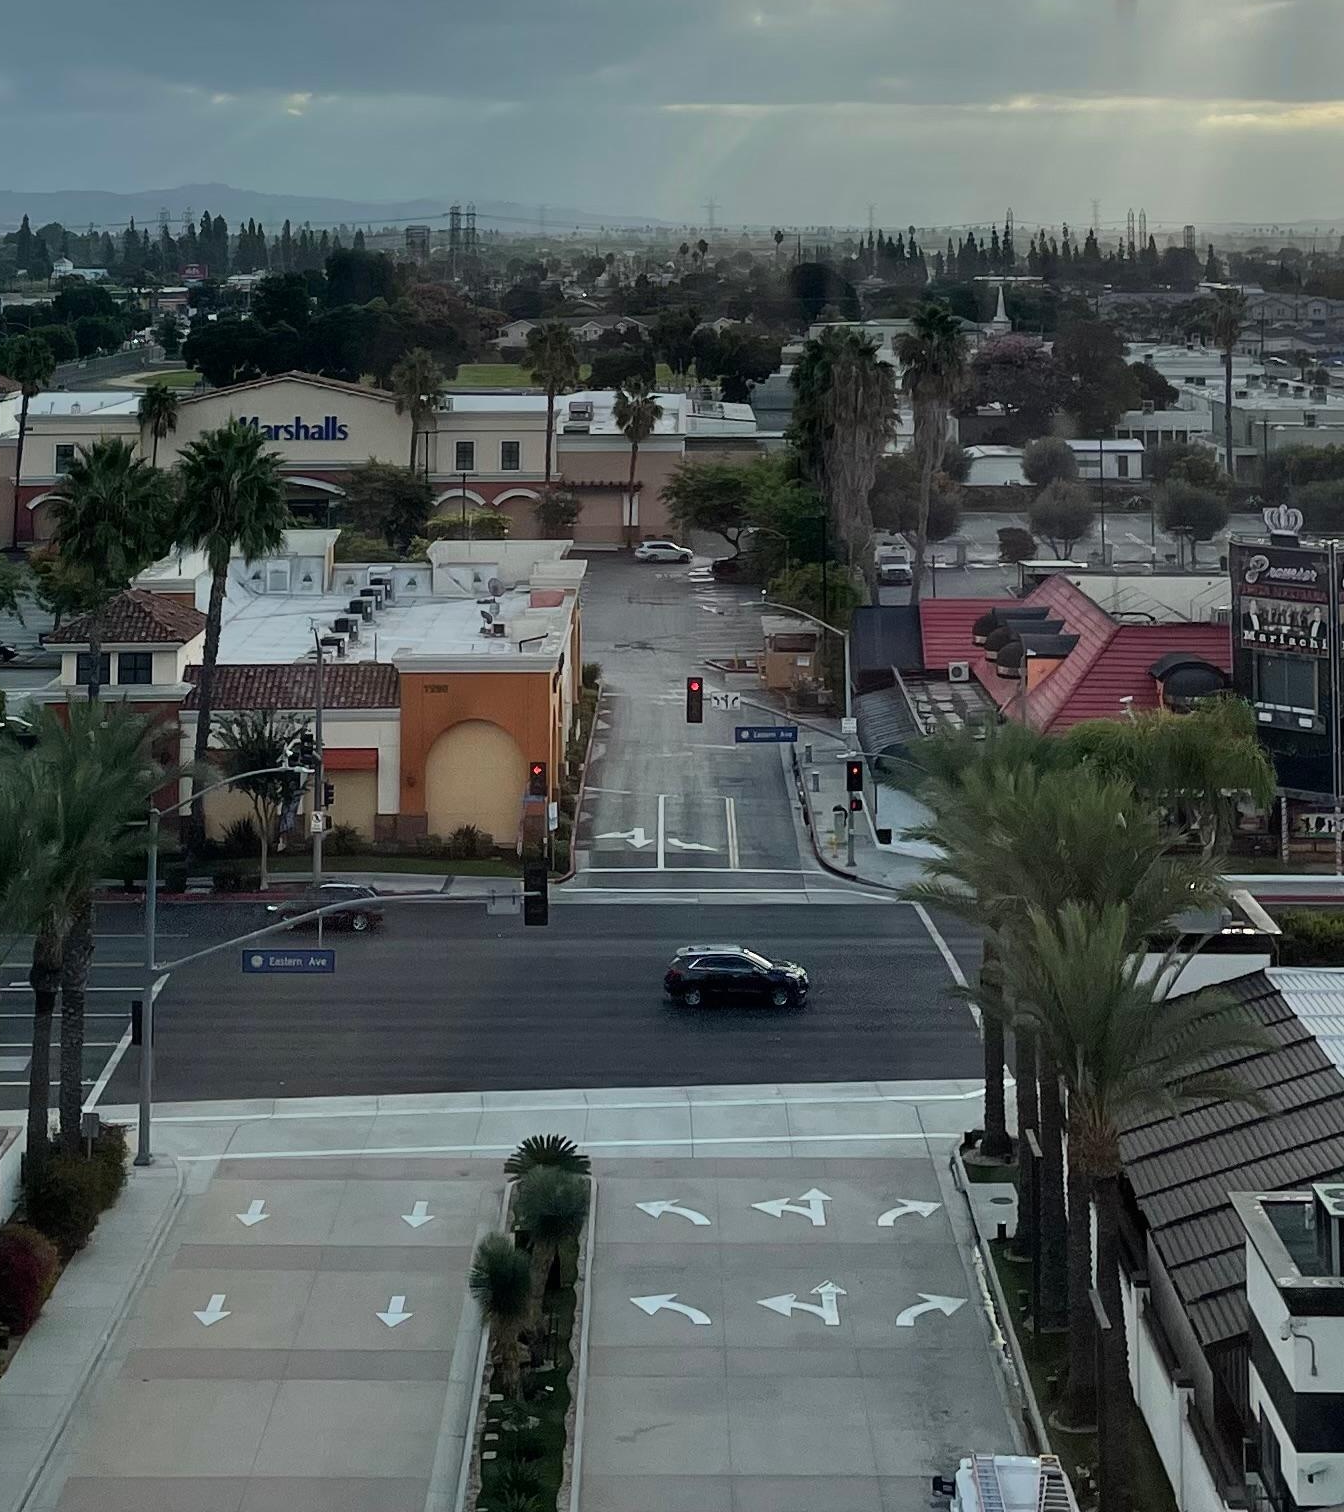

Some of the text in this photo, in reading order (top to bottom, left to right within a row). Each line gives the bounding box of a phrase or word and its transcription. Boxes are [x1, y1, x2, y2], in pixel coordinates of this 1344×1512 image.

[239, 416, 349, 441] Marshalls
[1243, 630, 1328, 650] Mariachi
[269, 957, 327, 967] Eastern Ave
